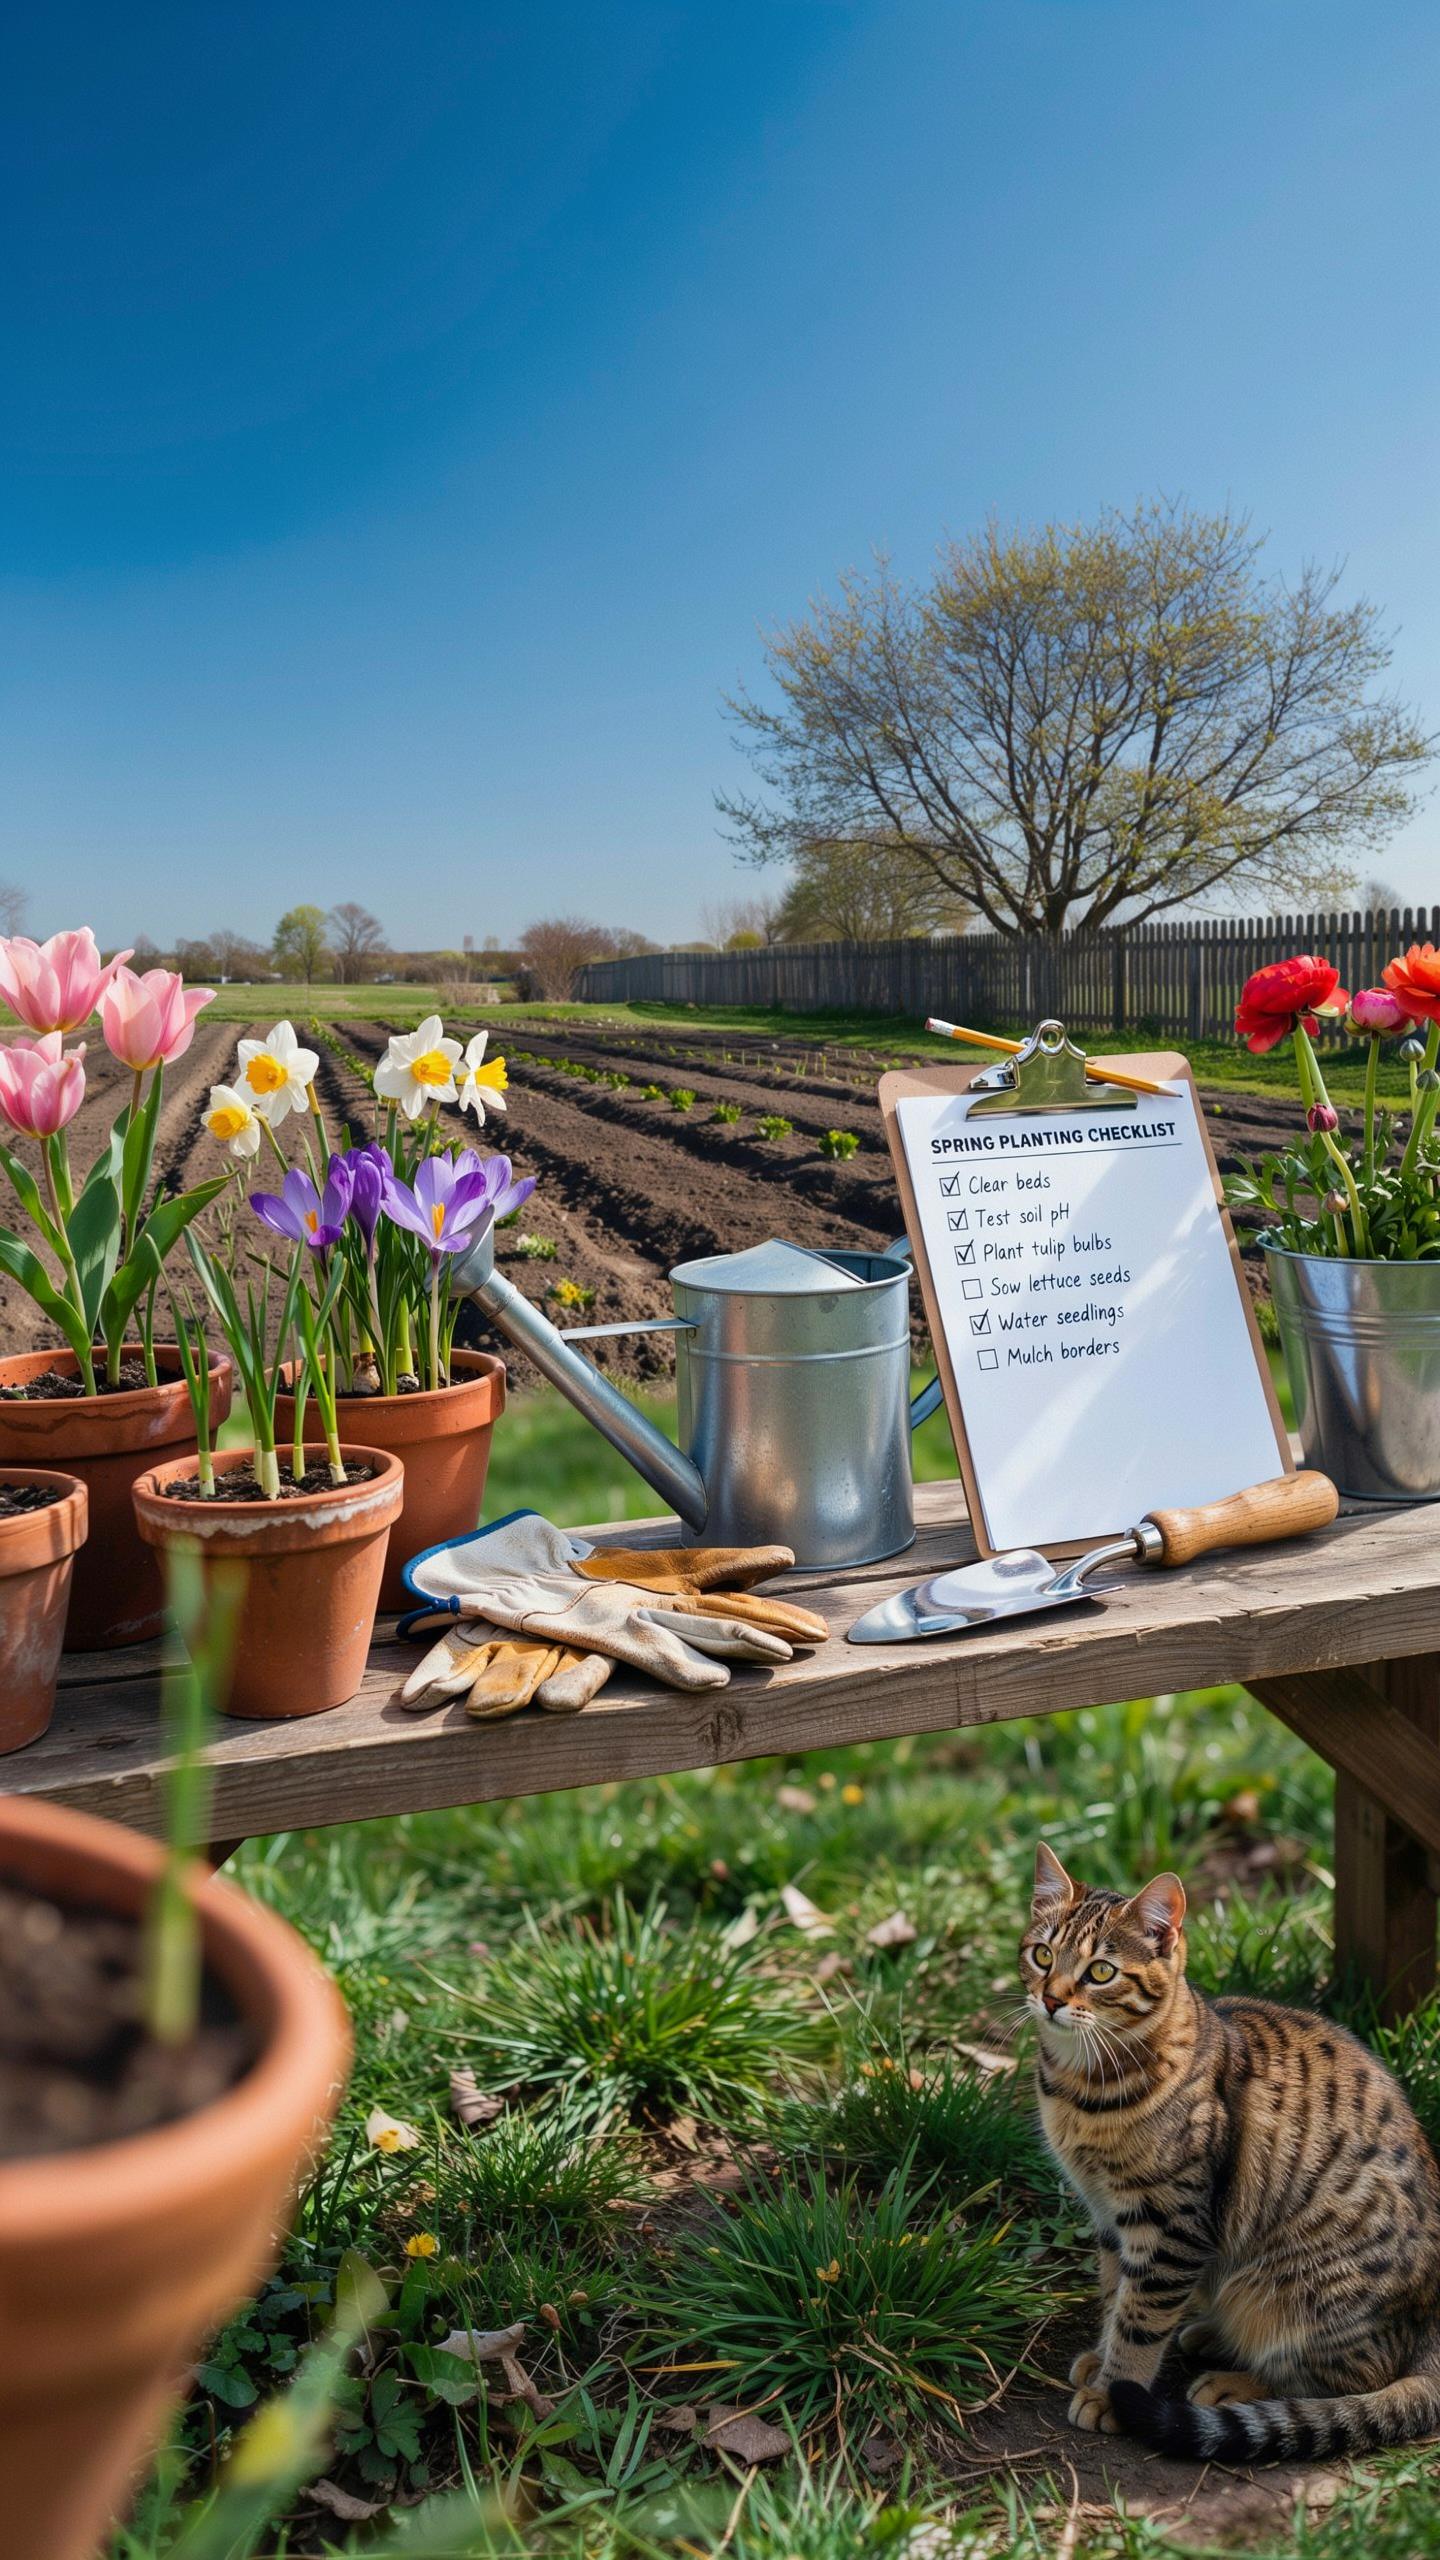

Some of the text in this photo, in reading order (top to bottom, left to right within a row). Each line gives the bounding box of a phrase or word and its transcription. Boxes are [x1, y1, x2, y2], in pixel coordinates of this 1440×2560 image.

[930, 1121, 1176, 1155] SPRING PLANTING CHECKLIST
[968, 1170, 1051, 1195] Clear beds
[974, 1201, 1070, 1229] Test soil pH
[983, 1232, 1112, 1263] Plant tulip bulbs
[990, 1264, 1131, 1297] Sow lettuce seeds
[997, 1302, 1125, 1331] Water seedlings
[1007, 1337, 1120, 1367] Mulch borders
